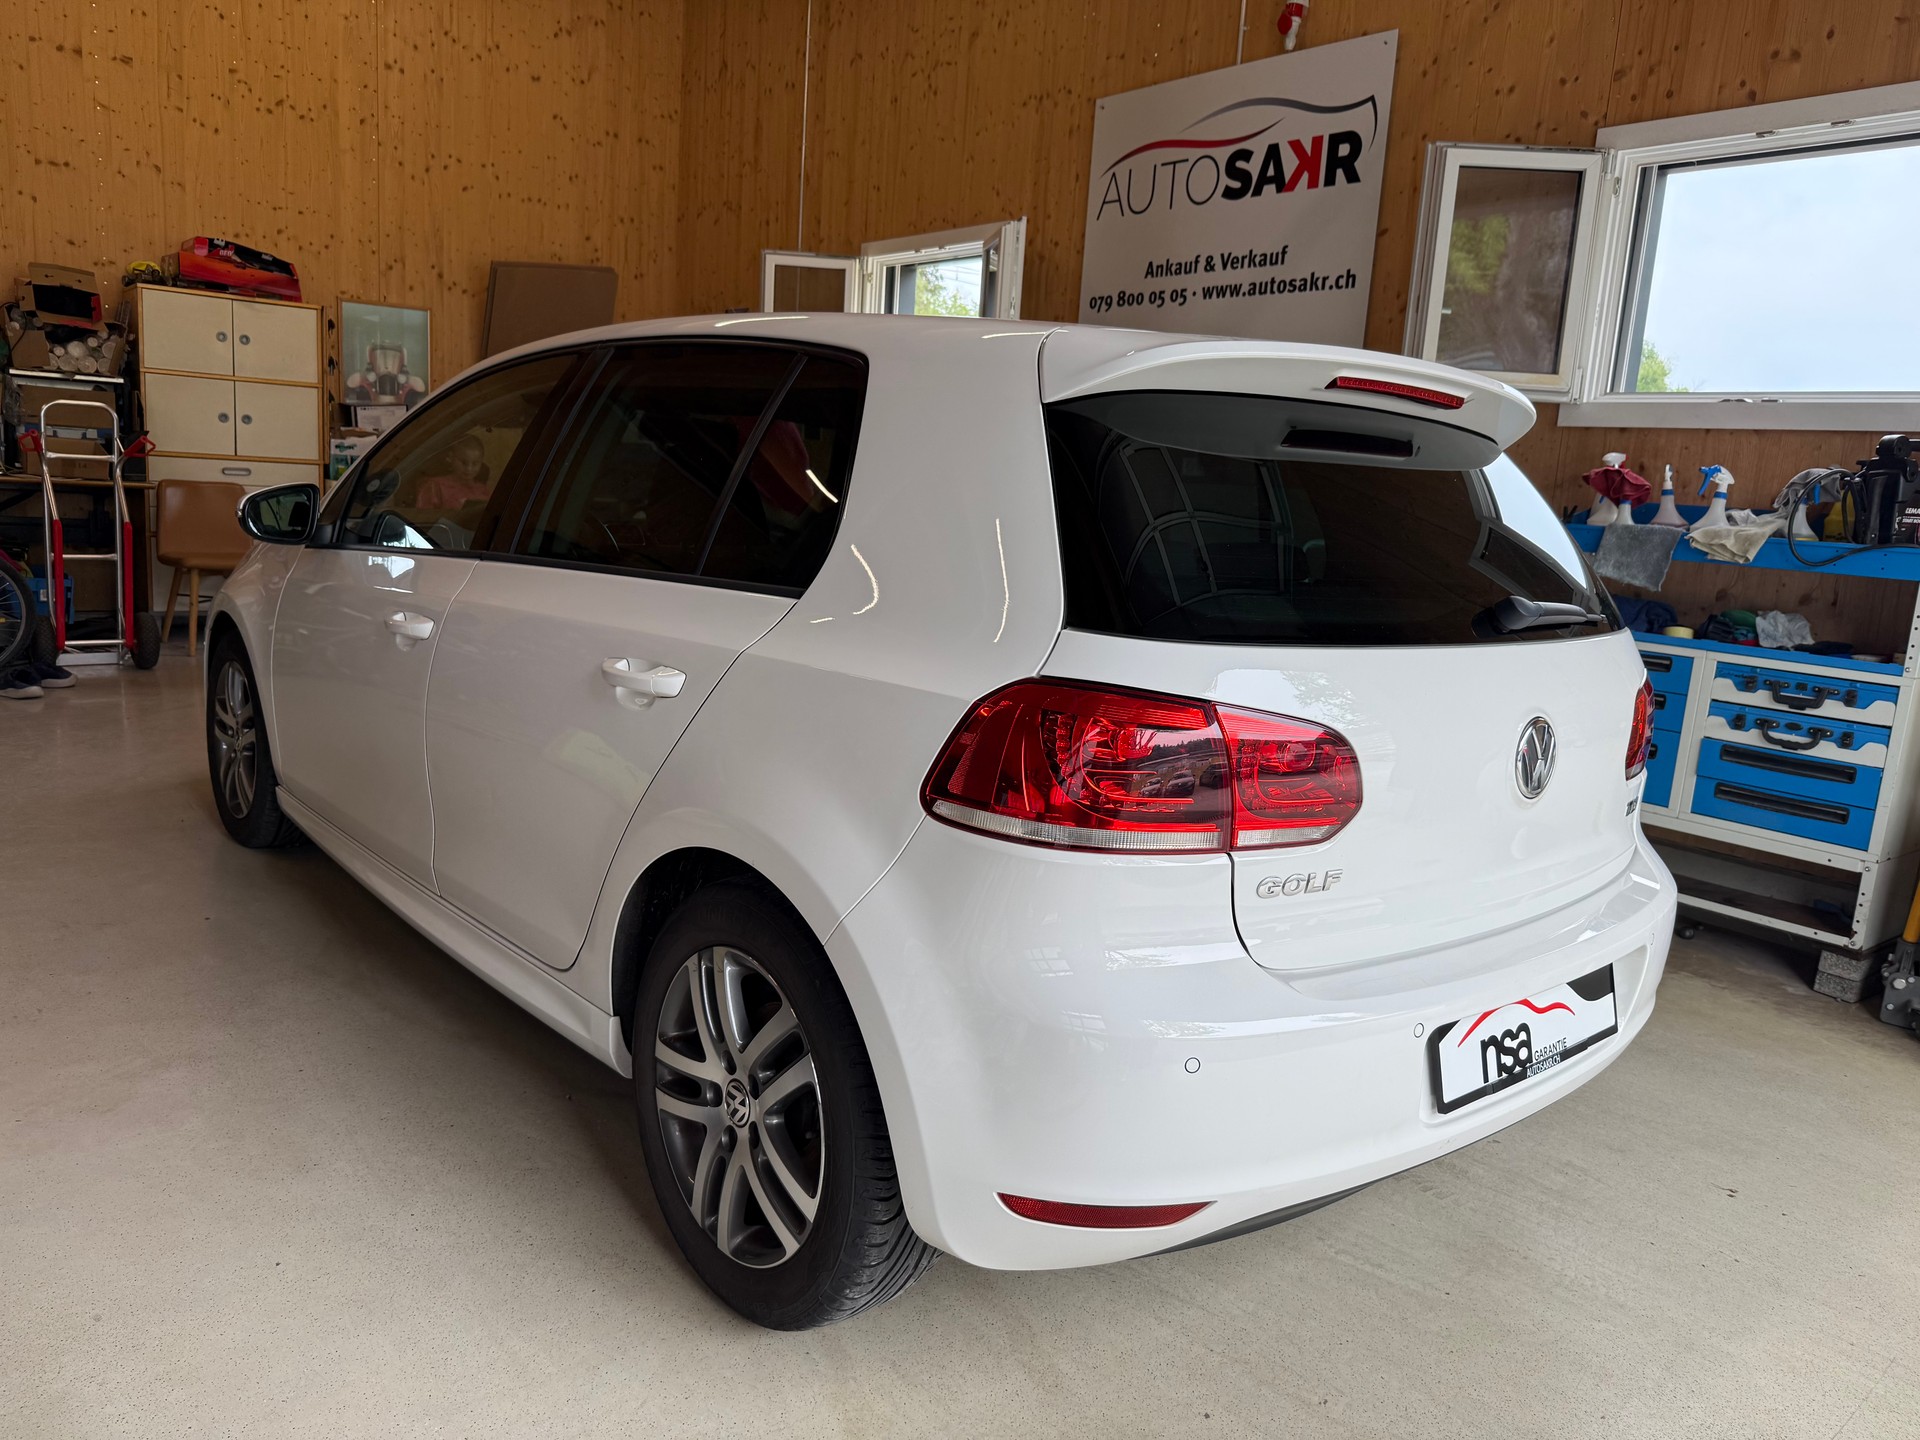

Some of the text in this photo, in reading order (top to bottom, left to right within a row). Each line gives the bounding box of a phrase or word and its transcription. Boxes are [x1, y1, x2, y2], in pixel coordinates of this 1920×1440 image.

[1144, 245, 1289, 279] Ankauf & Verkauf
[1089, 268, 1357, 313] 079 800 05 05 www.autosakr.ch
[1256, 868, 1343, 899] GOLF
[1480, 1022, 1533, 1084] nsa
[1534, 1037, 1567, 1061] GARANTIE
